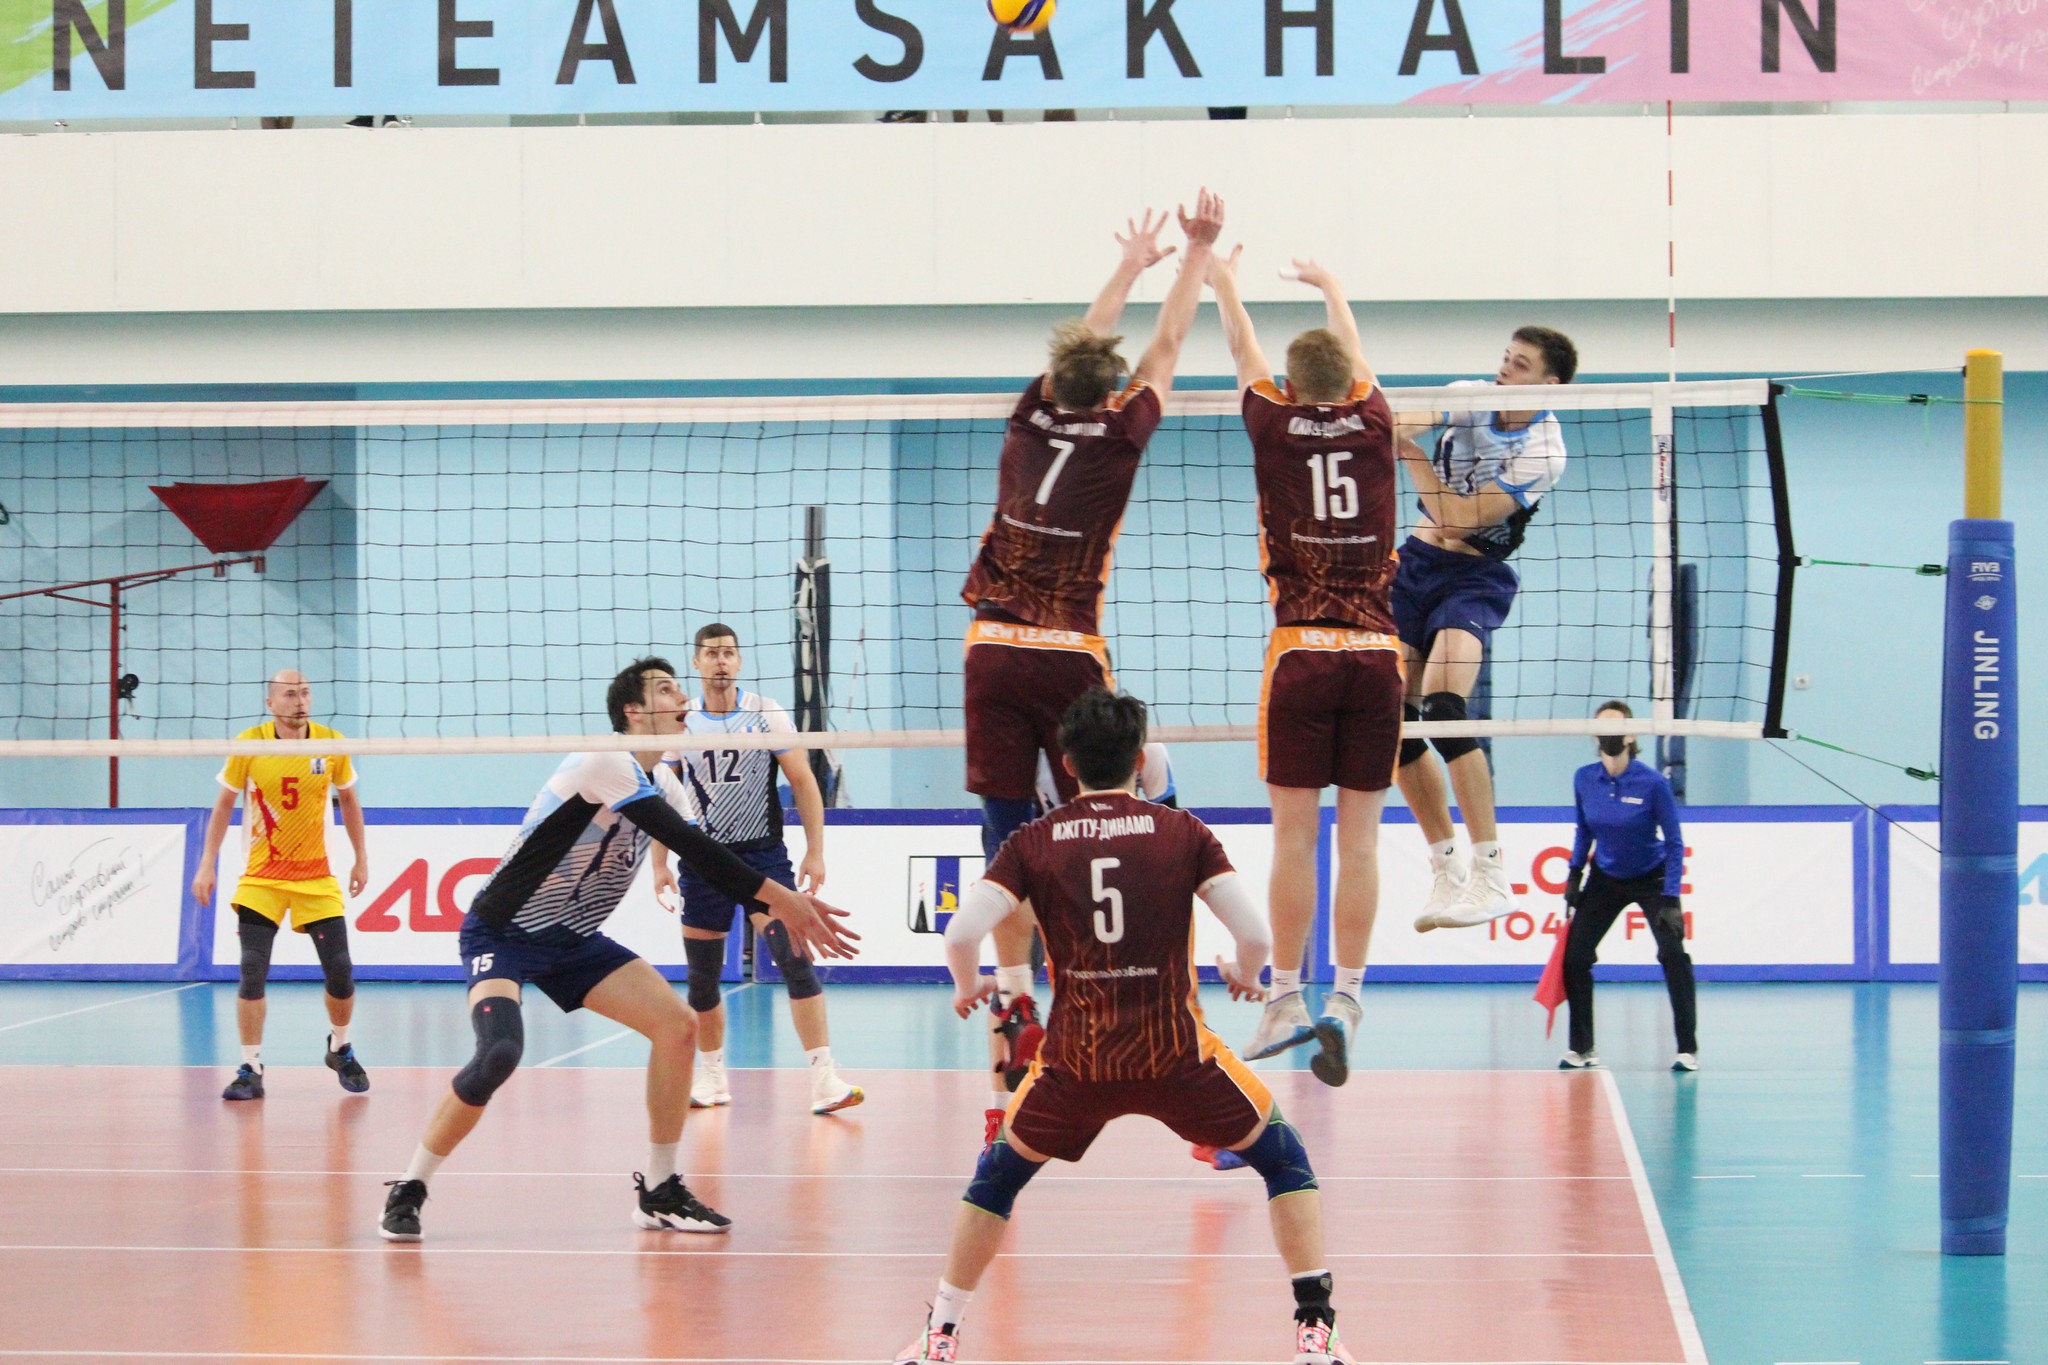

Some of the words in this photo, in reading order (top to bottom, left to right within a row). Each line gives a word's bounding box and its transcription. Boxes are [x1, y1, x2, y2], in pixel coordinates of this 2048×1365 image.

[1035, 438, 1075, 505] 7
[1306, 451, 1359, 521] 15
[1973, 630, 2000, 740] JINLING
[281, 776, 300, 811] 5
[702, 749, 741, 784] 12
[1090, 857, 1125, 944] 5
[471, 953, 494, 976] 15
